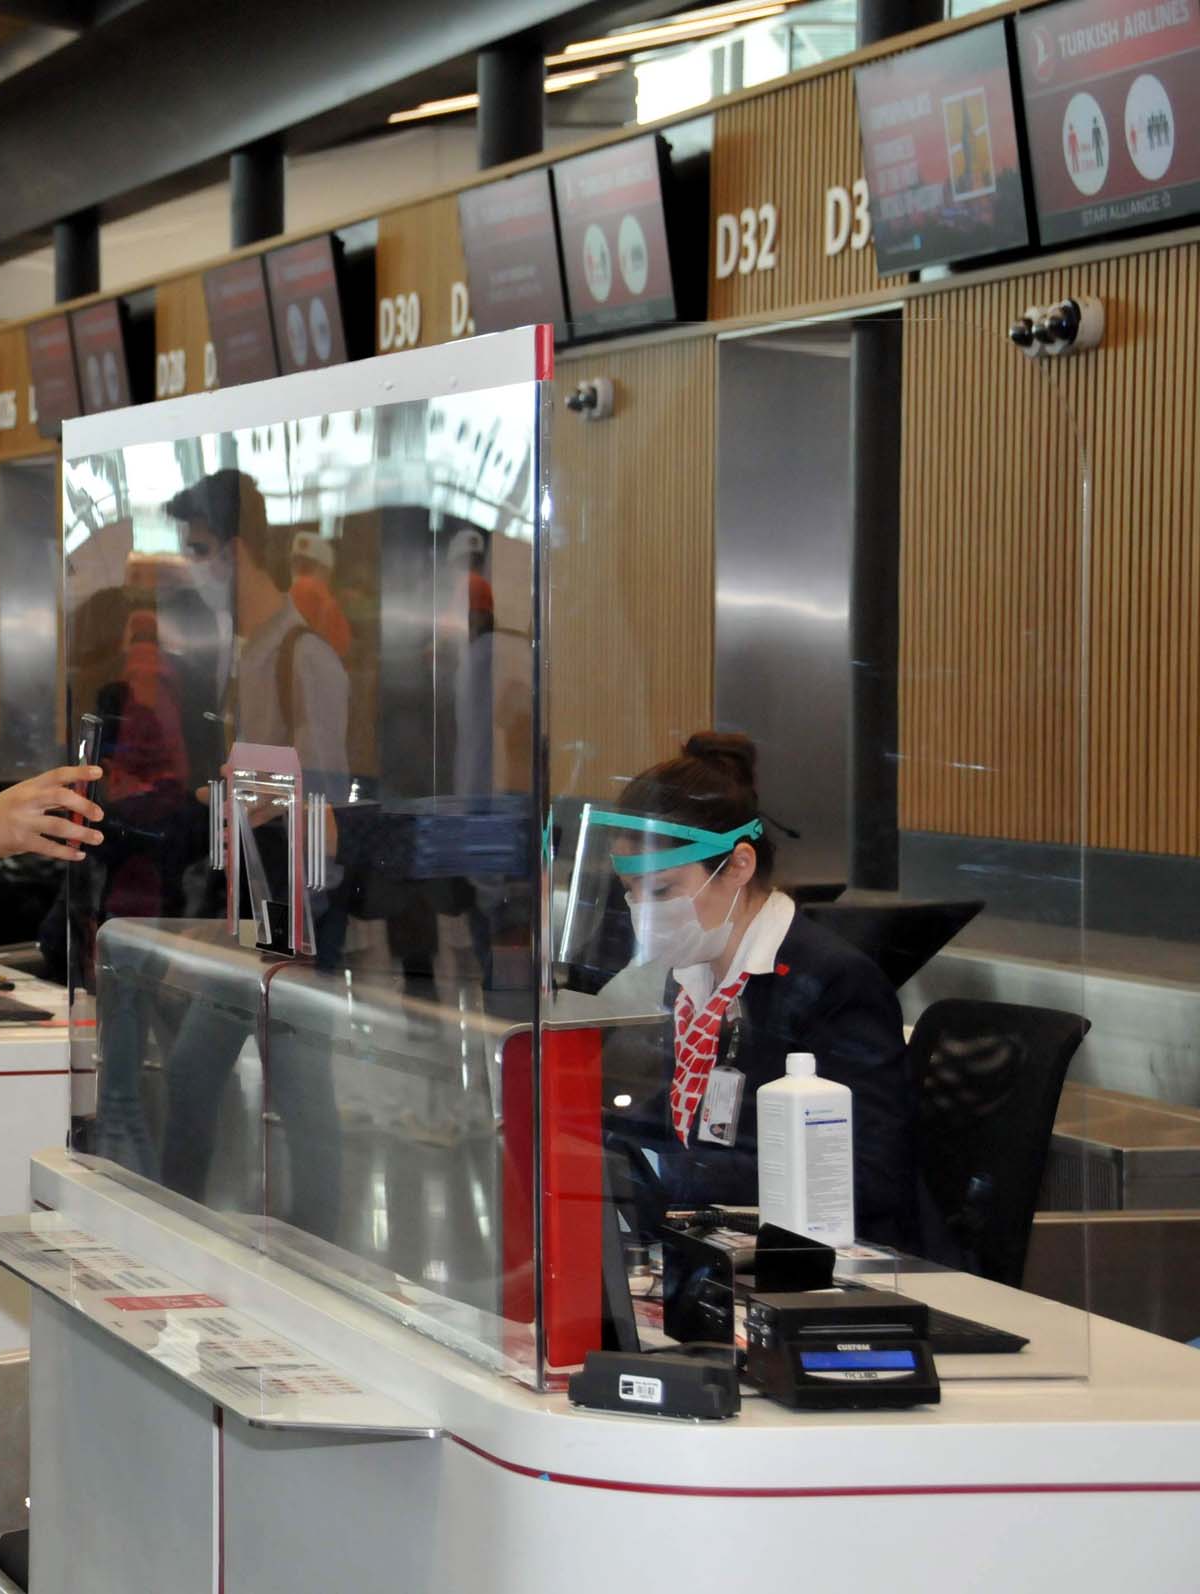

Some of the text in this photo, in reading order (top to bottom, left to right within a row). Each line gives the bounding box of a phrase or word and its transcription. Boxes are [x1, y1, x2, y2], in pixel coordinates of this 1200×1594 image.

[1057, 0, 1189, 59] TURKISH AIRLINES
[825, 178, 874, 257] D3
[1082, 195, 1160, 227] STAR ALLIANCE
[715, 203, 778, 279] D32
[379, 291, 420, 351] D30
[451, 281, 475, 337] D
